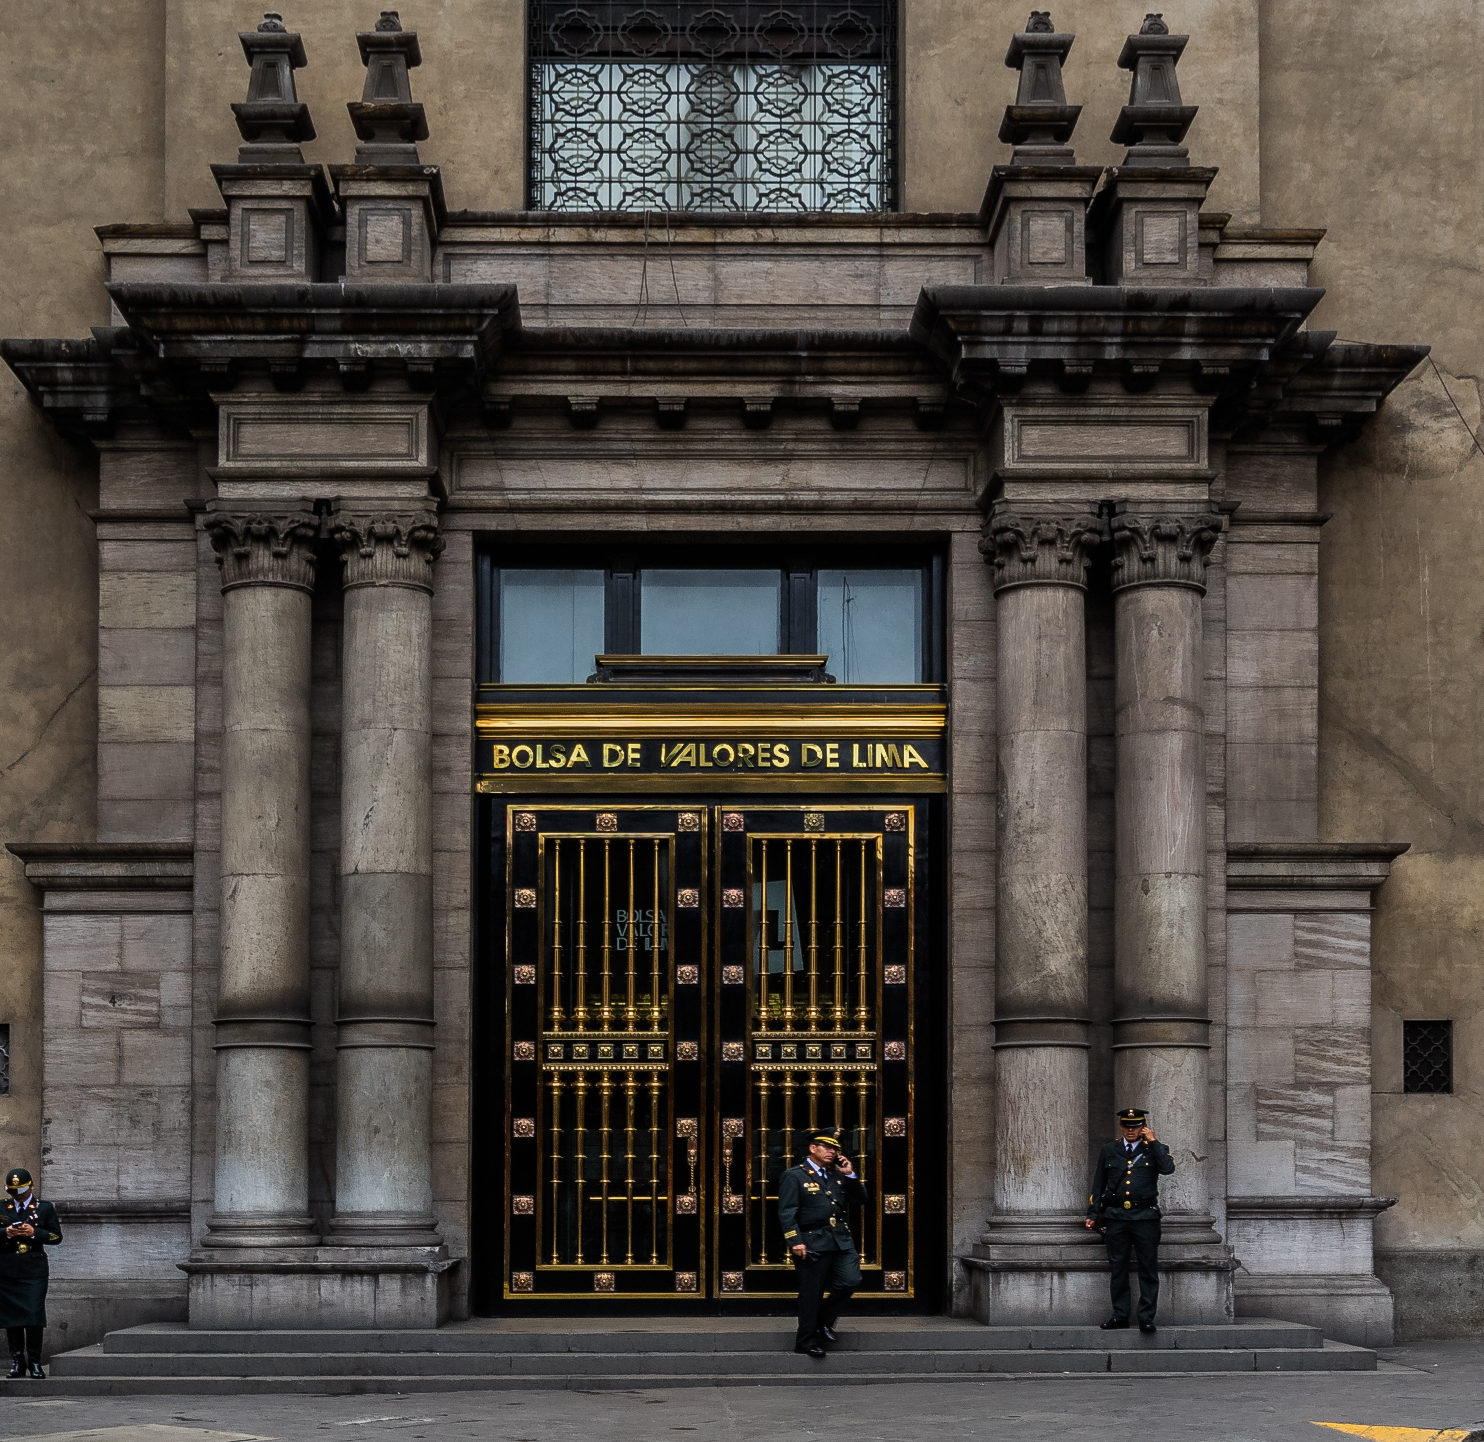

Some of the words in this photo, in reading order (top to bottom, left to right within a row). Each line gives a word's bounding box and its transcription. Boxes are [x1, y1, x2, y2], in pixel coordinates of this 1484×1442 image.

[493, 743, 592, 769] BOLSA
[602, 743, 641, 768] DE
[660, 743, 790, 768] VALORES
[801, 743, 839, 768] DE
[852, 743, 929, 768] LIMA
